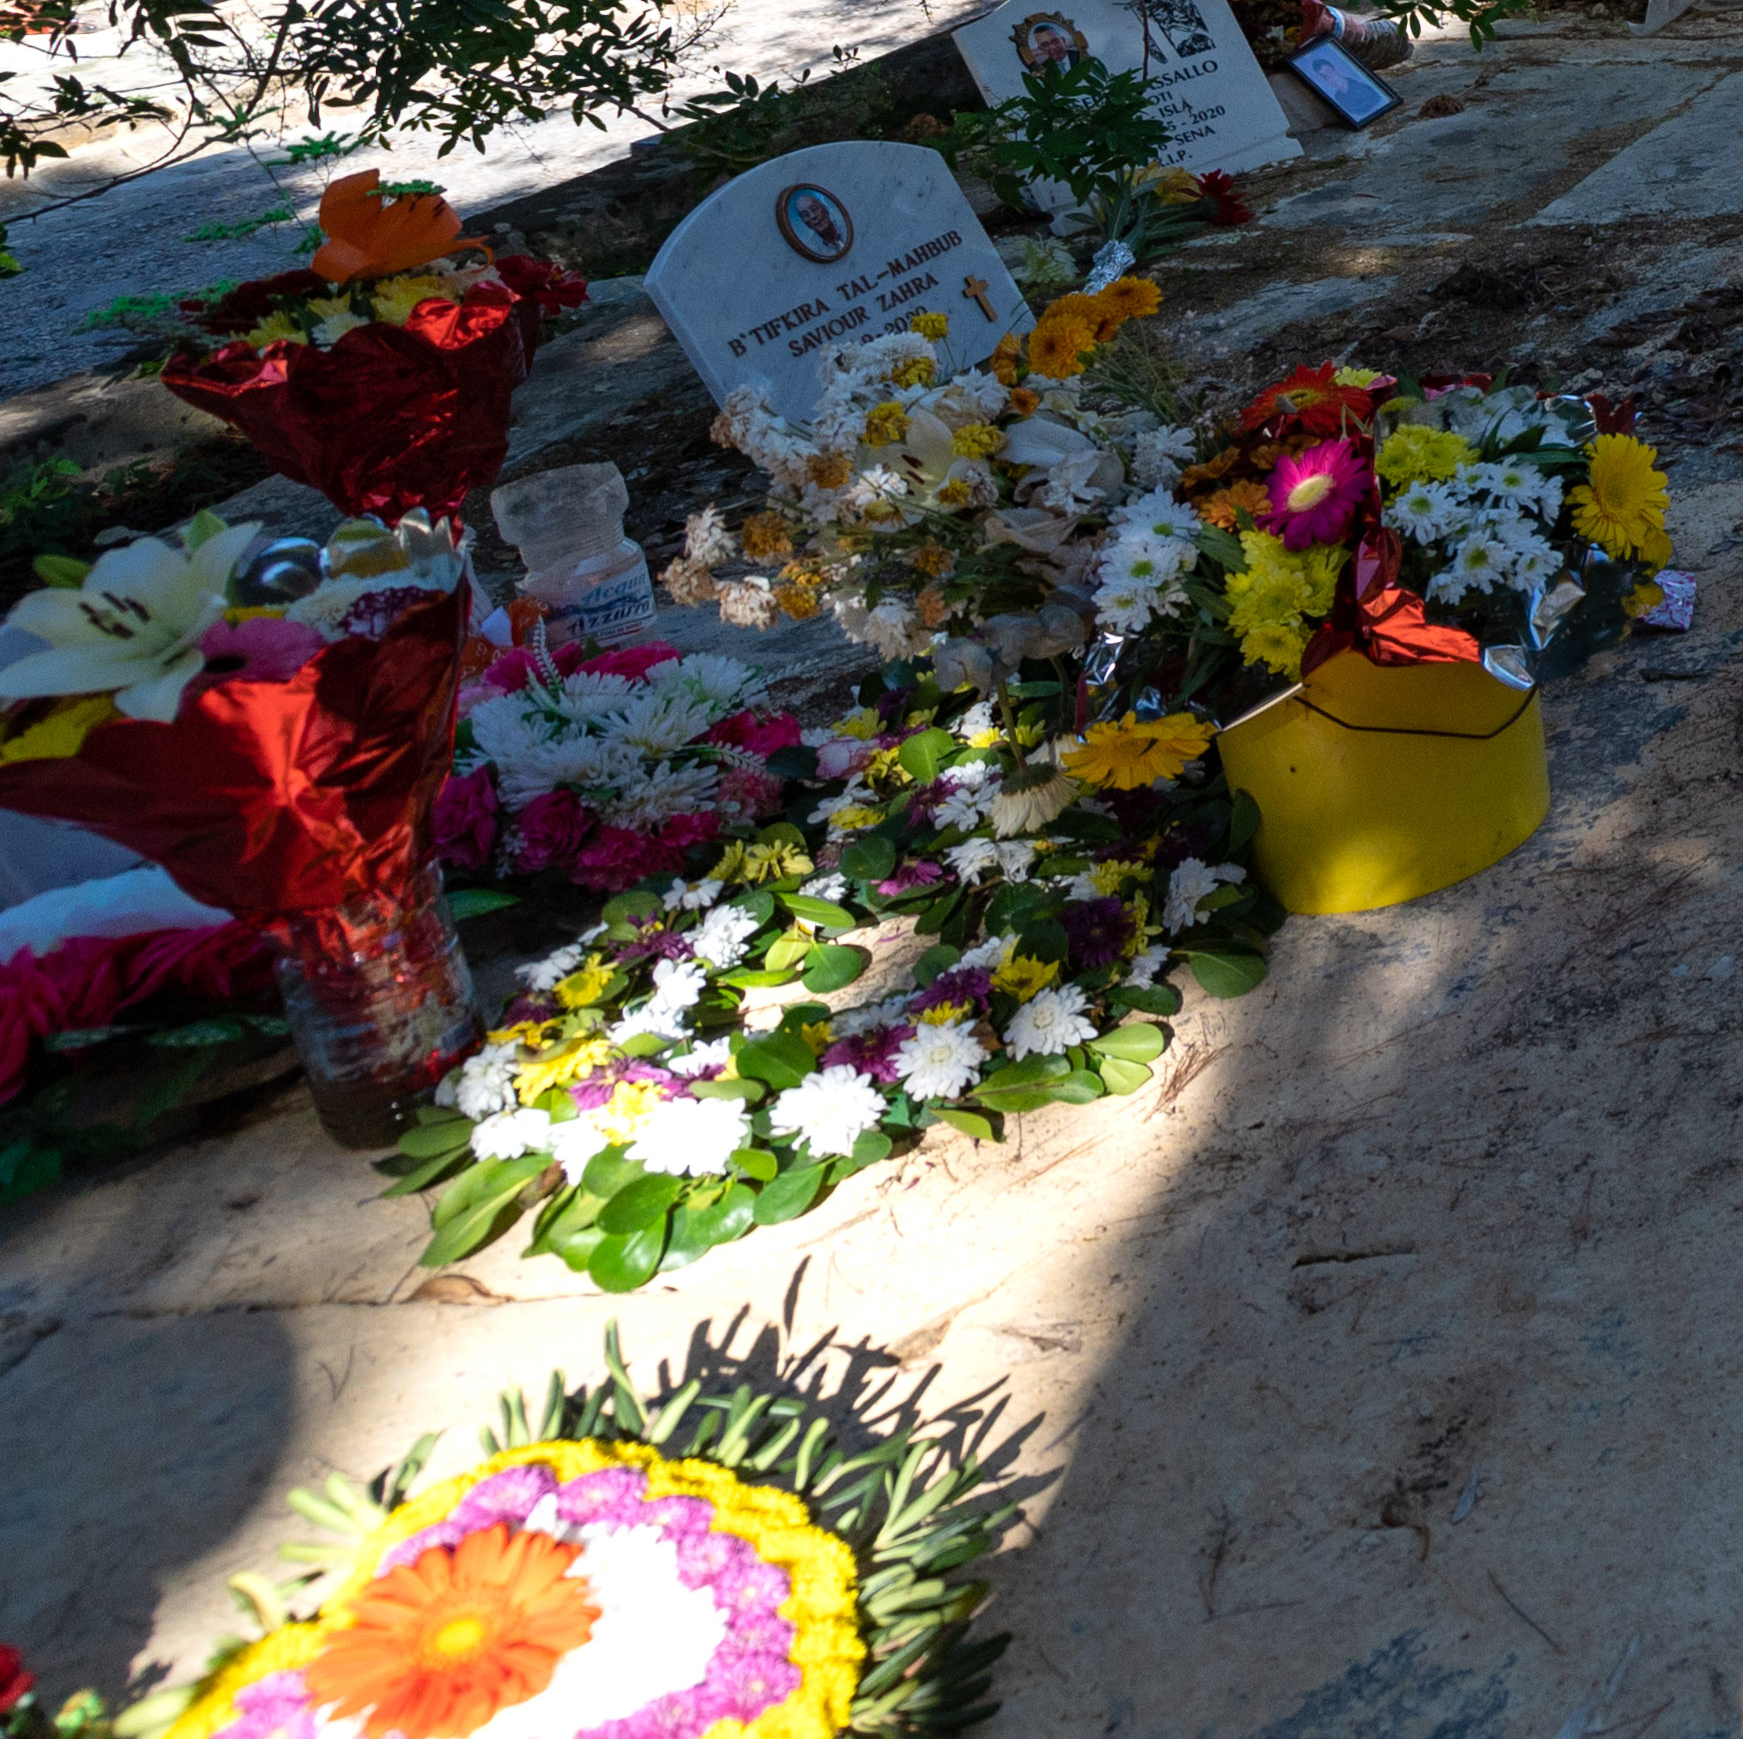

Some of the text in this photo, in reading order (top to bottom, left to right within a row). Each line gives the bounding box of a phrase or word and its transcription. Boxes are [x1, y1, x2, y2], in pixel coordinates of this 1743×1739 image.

[1149, 91, 1173, 107] OTI
[1157, 100, 1194, 120] ISLA
[1191, 104, 1226, 126] 2020
[1173, 125, 1217, 147] SENA
[787, 271, 940, 358] SAVIOUR ZAHRA
[582, 572, 647, 604] Acqua
[565, 599, 651, 636] Azzurra
